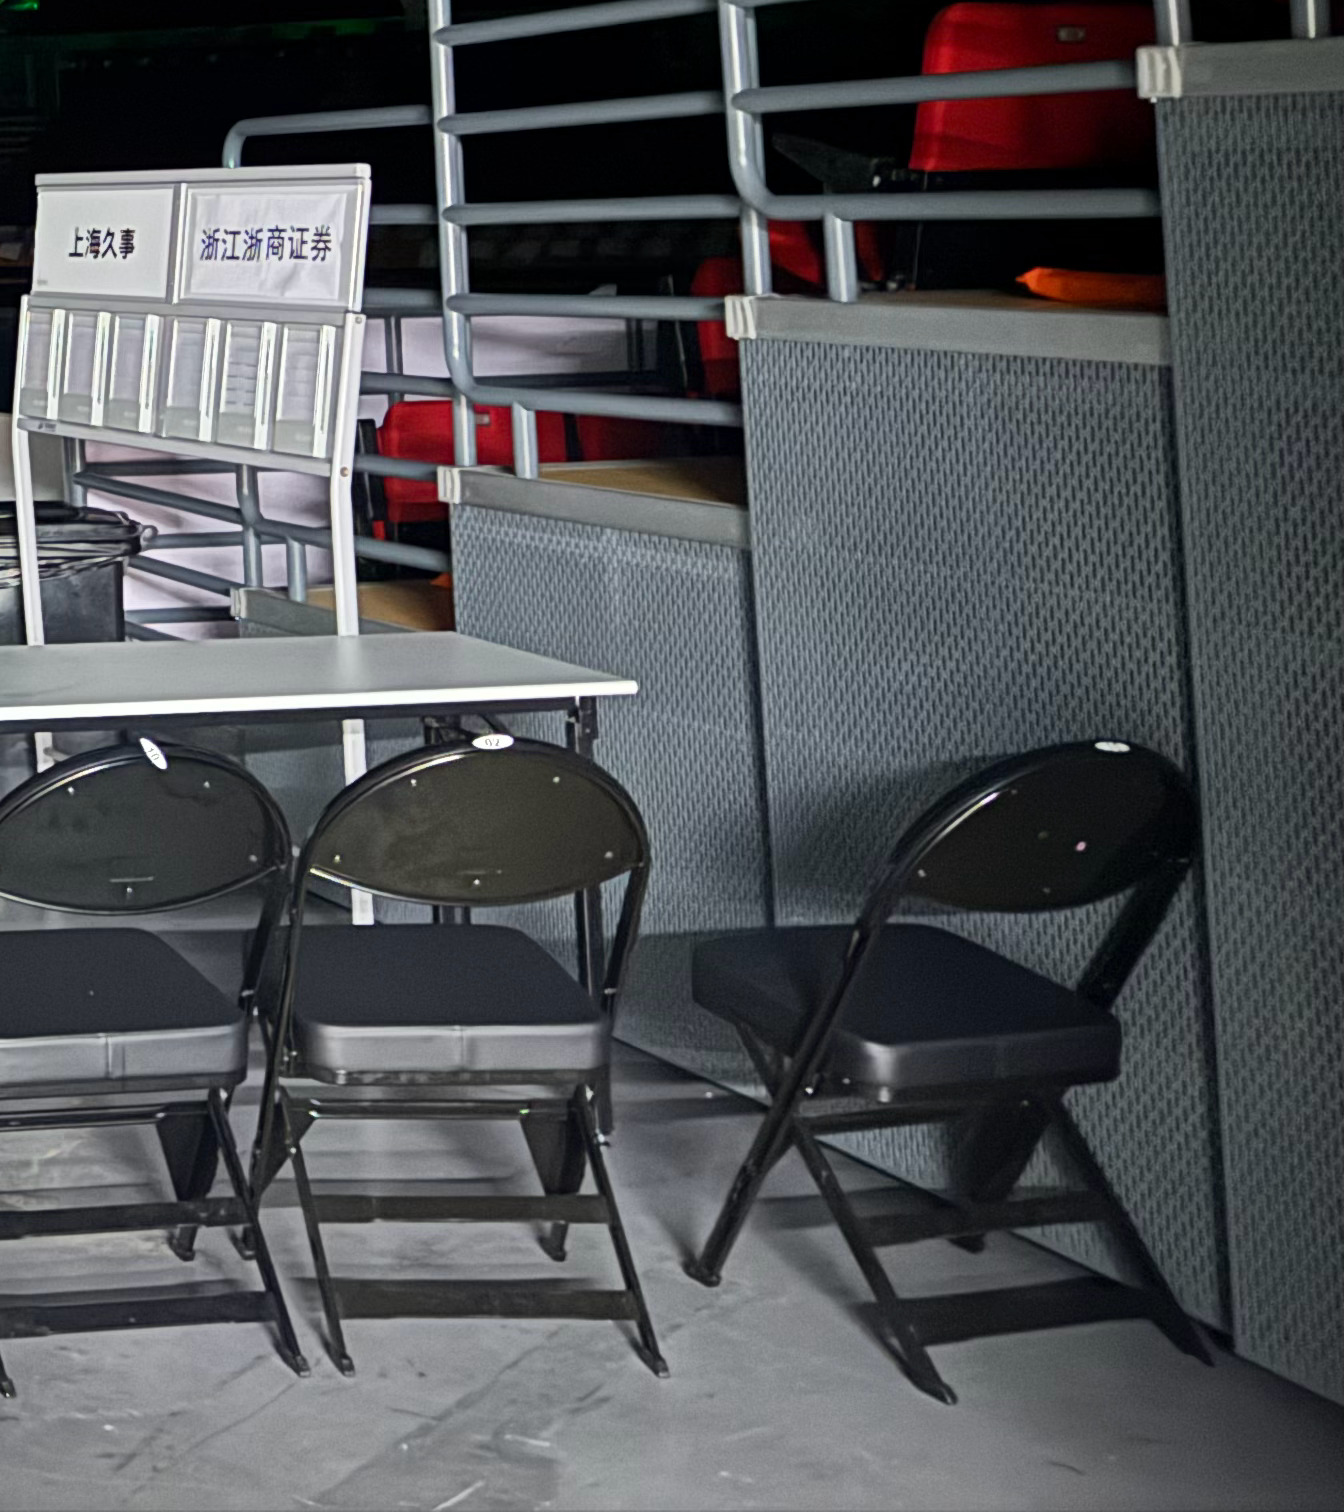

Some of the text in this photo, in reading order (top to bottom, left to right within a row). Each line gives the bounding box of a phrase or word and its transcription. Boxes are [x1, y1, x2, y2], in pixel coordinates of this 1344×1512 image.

[68, 227, 136, 259] 上海久事
[200, 225, 332, 262] 浙江浙商证券
